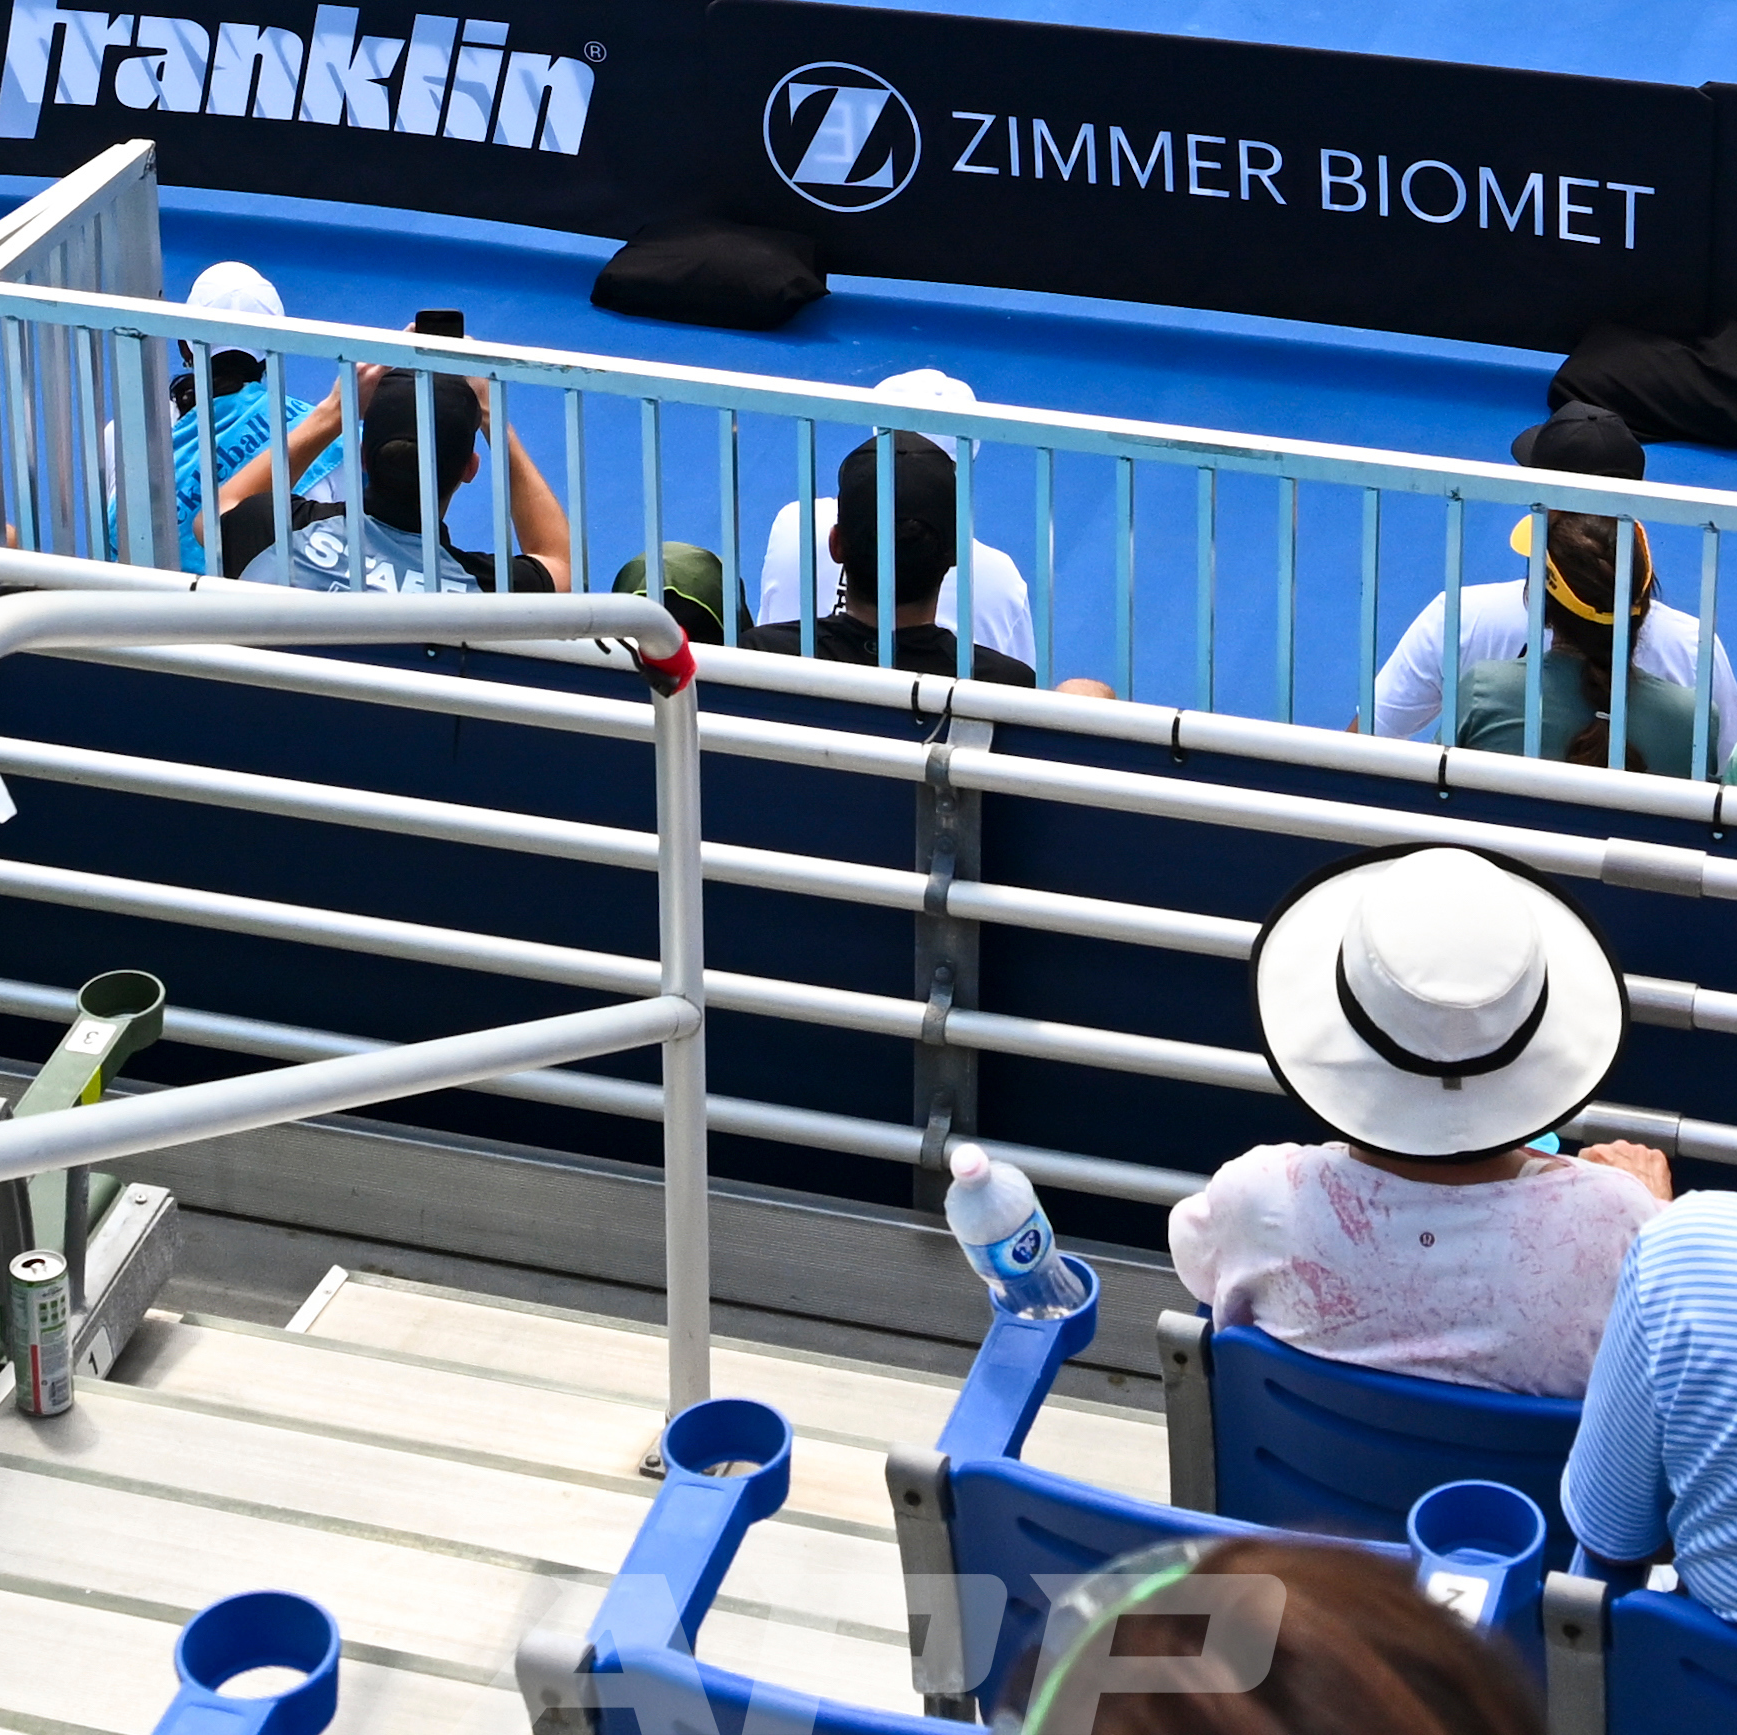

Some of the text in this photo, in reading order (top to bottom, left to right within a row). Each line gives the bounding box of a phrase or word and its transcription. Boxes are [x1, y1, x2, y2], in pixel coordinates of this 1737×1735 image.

[951, 110, 1655, 250] ZIMMER BIOMET
[89, 1350, 98, 1376] 1
